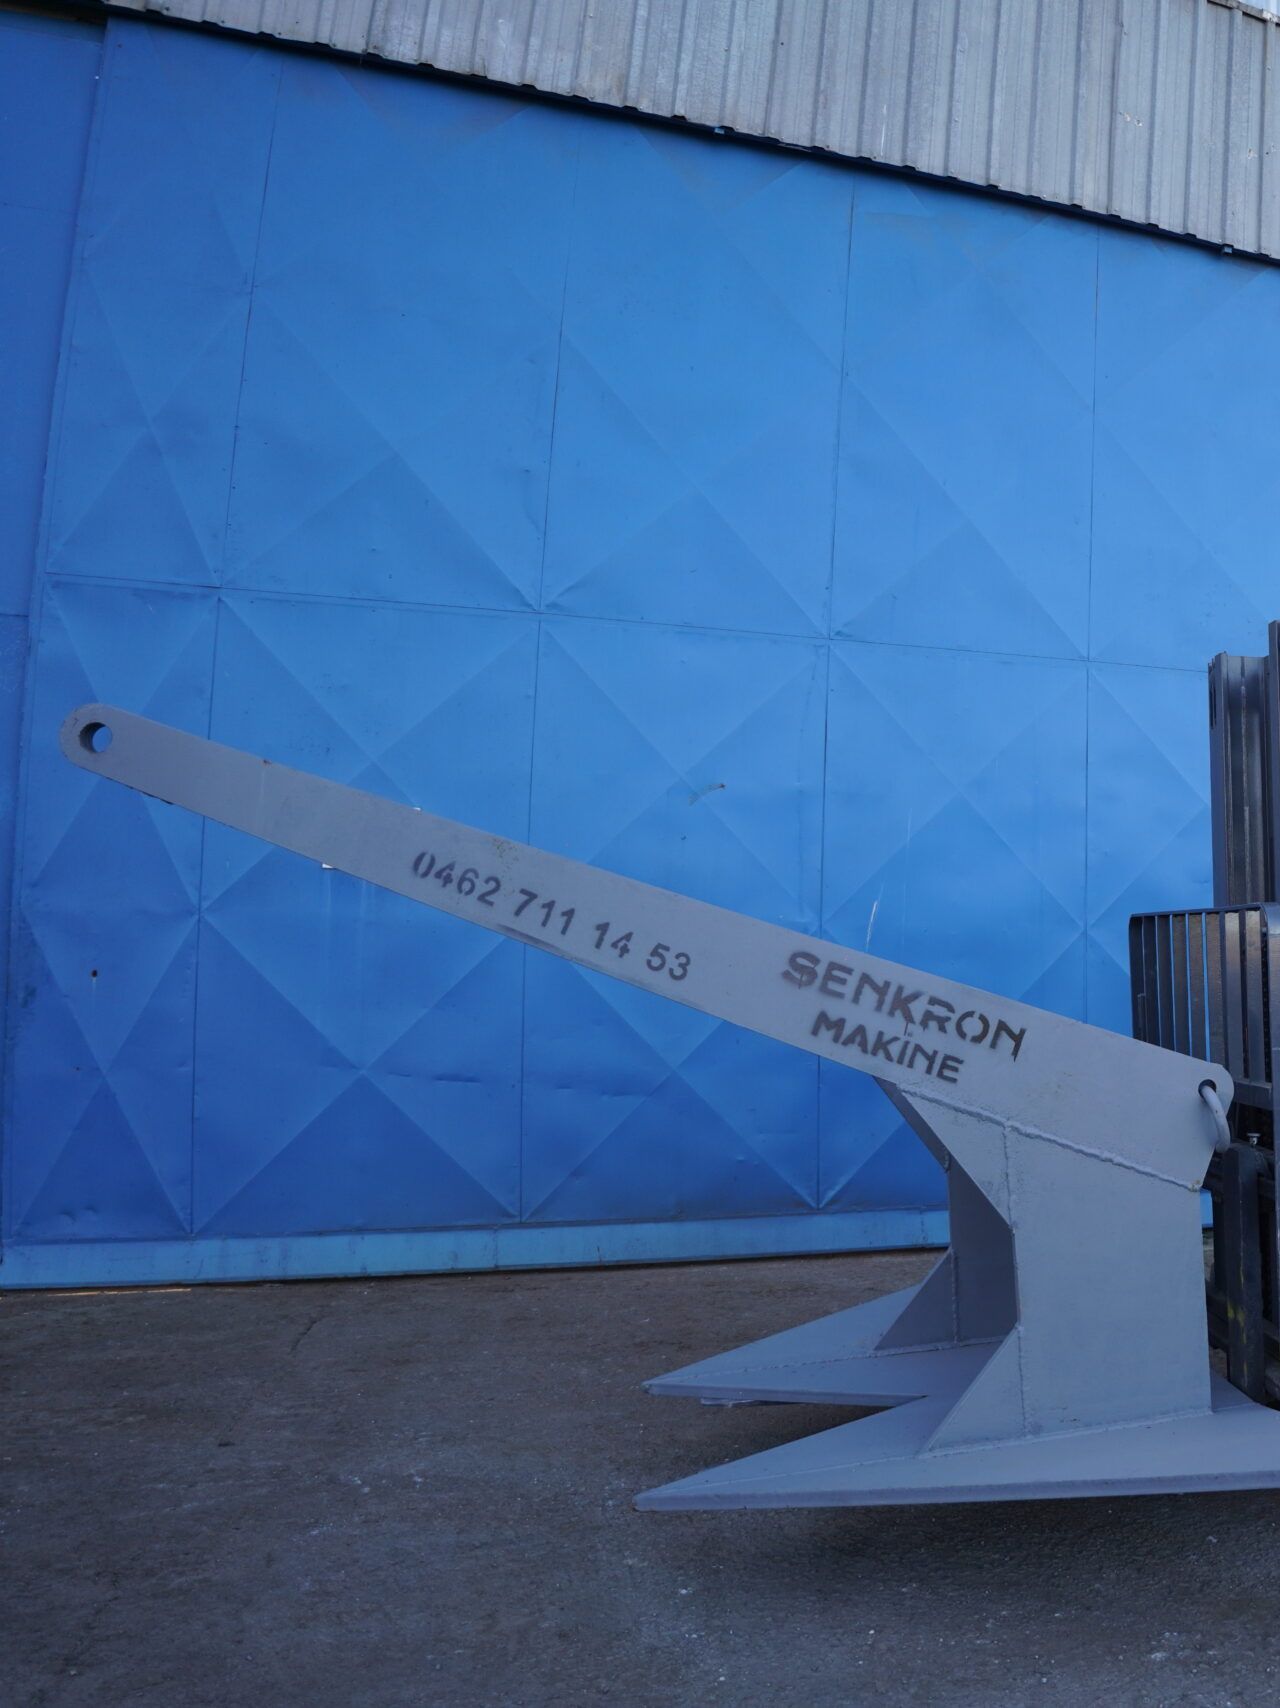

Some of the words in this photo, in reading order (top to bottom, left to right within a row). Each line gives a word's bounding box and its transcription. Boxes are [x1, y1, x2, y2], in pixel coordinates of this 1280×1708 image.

[412, 851, 502, 906] 0462
[513, 888, 576, 935] 711
[594, 921, 635, 958] 14
[646, 942, 691, 981] 53
[782, 951, 1027, 1062] SENKRON
